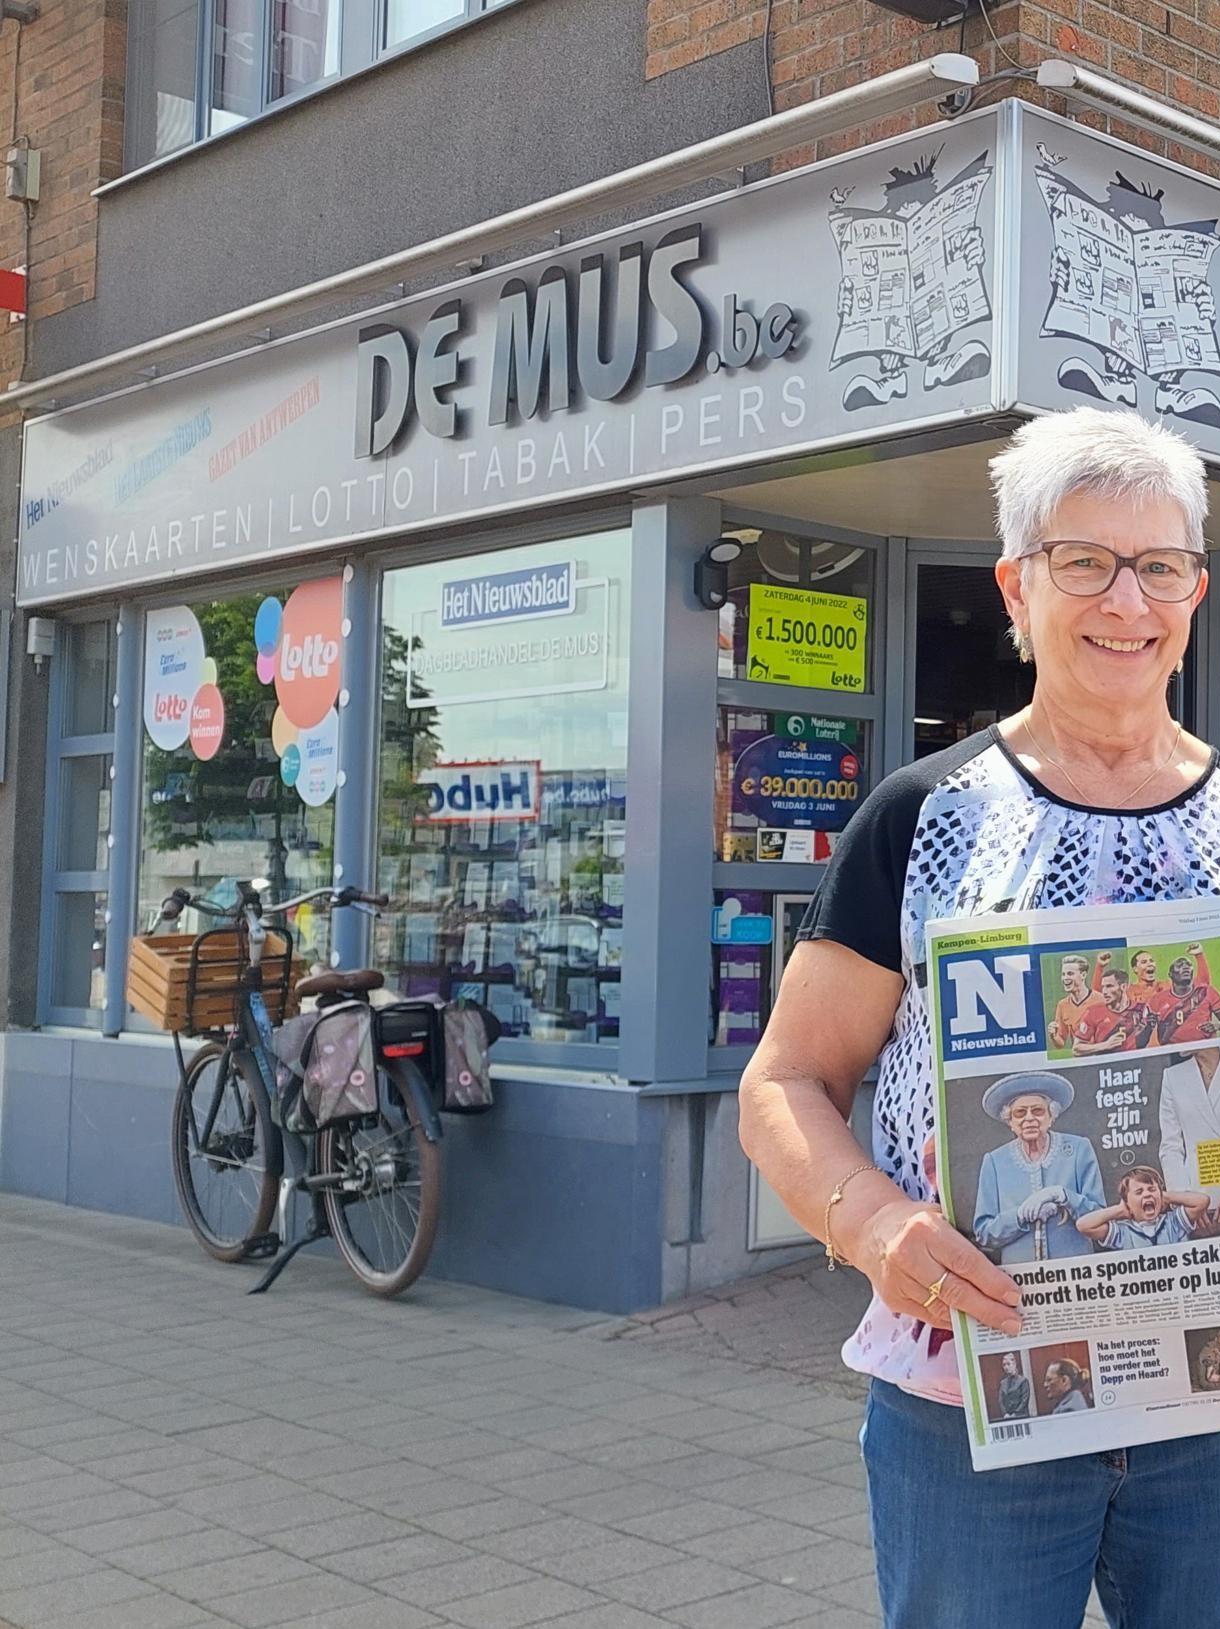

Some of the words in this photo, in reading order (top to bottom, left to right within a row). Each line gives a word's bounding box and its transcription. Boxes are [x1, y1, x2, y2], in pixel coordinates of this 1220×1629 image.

[355, 298, 463, 459] DE
[208, 439, 236, 482] GAZET
[238, 423, 257, 459] VAN
[258, 375, 320, 446] ANTWERPEN
[23, 503, 251, 589] WENSKAARTEN
[288, 466, 414, 533] LOTTO
[458, 421, 605, 491] TABAK
[661, 376, 807, 454] PERS
[25, 496, 44, 529] Het
[47, 440, 113, 513] Nieuwsblad
[442, 585, 469, 621] Het
[470, 569, 568, 616] Nieuwsblad
[764, 590, 804, 603] ZATERDAG
[811, 595, 828, 606] JUNI
[829, 599, 848, 608] 2022
[756, 626, 763, 640] €
[765, 616, 857, 651] 1.500.000
[415, 642, 535, 674] DAGBLADHANDEL
[541, 637, 562, 660] DE
[564, 632, 599, 657] MUS
[192, 705, 211, 718] Kom
[192, 725, 221, 737] winnen
[811, 716, 846, 730] Nationale
[815, 729, 840, 741] Loterij
[778, 750, 832, 762] EUROMILLIONS
[741, 777, 756, 795] €
[760, 775, 858, 800] 39.000.000
[771, 800, 806, 810] VRIJDAG
[808, 801, 813, 810] 3
[815, 802, 835, 811] JUNI
[937, 933, 1021, 950] Kempen-Limburg
[947, 954, 1031, 1035] N
[951, 1032, 1036, 1051] Nieuwsblad
[1099, 1068, 1142, 1088] Haar
[1096, 1087, 1148, 1108] feest,
[1107, 1107, 1140, 1130] zijn
[1101, 1129, 1148, 1150] show
[1007, 1269, 1067, 1288] onden
[1071, 1266, 1092, 1279] na
[1096, 1255, 1178, 1283] spontane
[1021, 1286, 1072, 1307] wordt
[1075, 1279, 1116, 1301] hete
[1120, 1276, 1173, 1297] zomer
[1179, 1274, 1201, 1292] op
[1097, 1342, 1108, 1350] Na
[1111, 1340, 1125, 1349] het
[1128, 1339, 1160, 1349] proces:
[1098, 1353, 1114, 1361] hoe
[1117, 1350, 1138, 1359] moet
[1141, 1348, 1155, 1357] het
[1113, 1361, 1141, 1371] verder
[1143, 1358, 1160, 1368] met
[1101, 1375, 1123, 1385] Depp
[1138, 1368, 1169, 1379] Heard?
